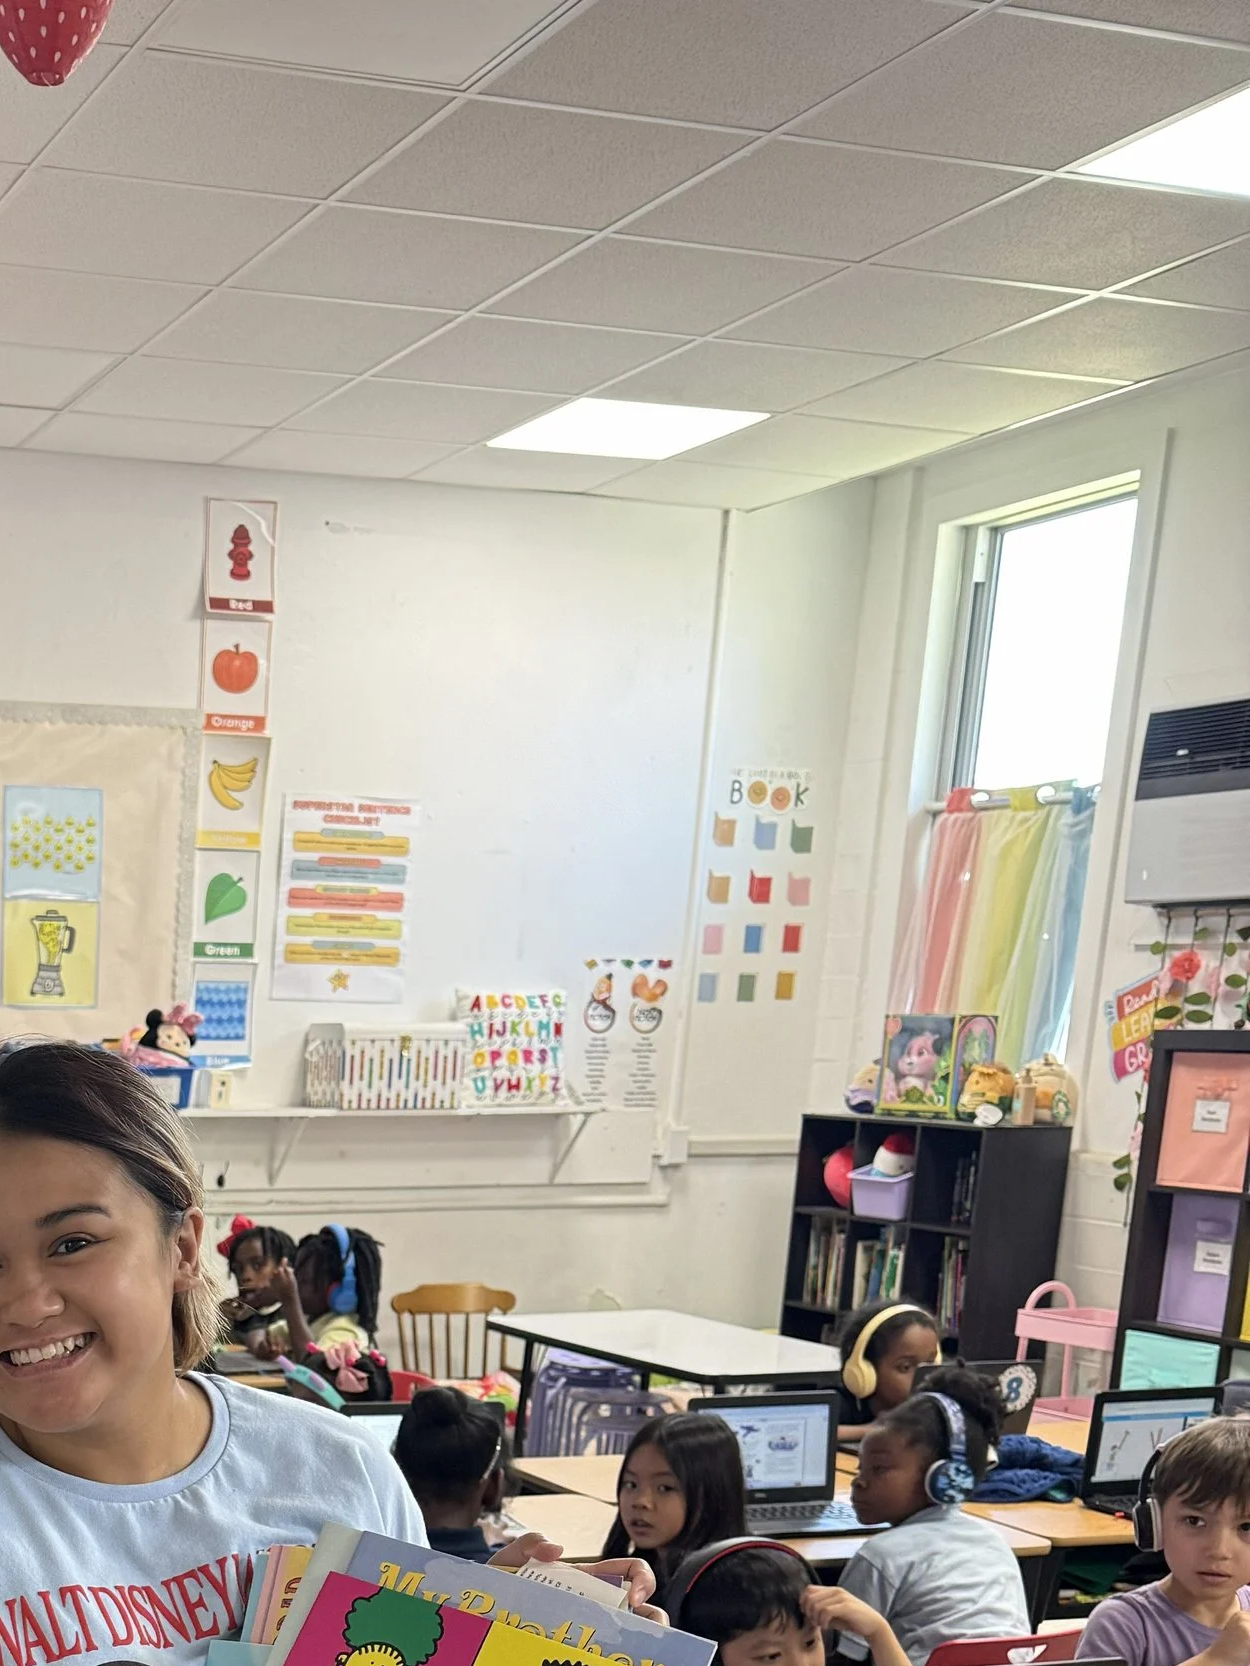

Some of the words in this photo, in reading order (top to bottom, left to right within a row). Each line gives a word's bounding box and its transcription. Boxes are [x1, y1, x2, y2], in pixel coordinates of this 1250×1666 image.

[229, 599, 252, 611] Red
[211, 716, 255, 729] Orange
[205, 944, 240, 956] Green
[1122, 1012, 1151, 1042] LEA
[206, 1056, 229, 1066] Blue
[1125, 1042, 1147, 1072] GR
[1005, 1376, 1023, 1403] 8
[88, 1554, 241, 1652] DISNEY
